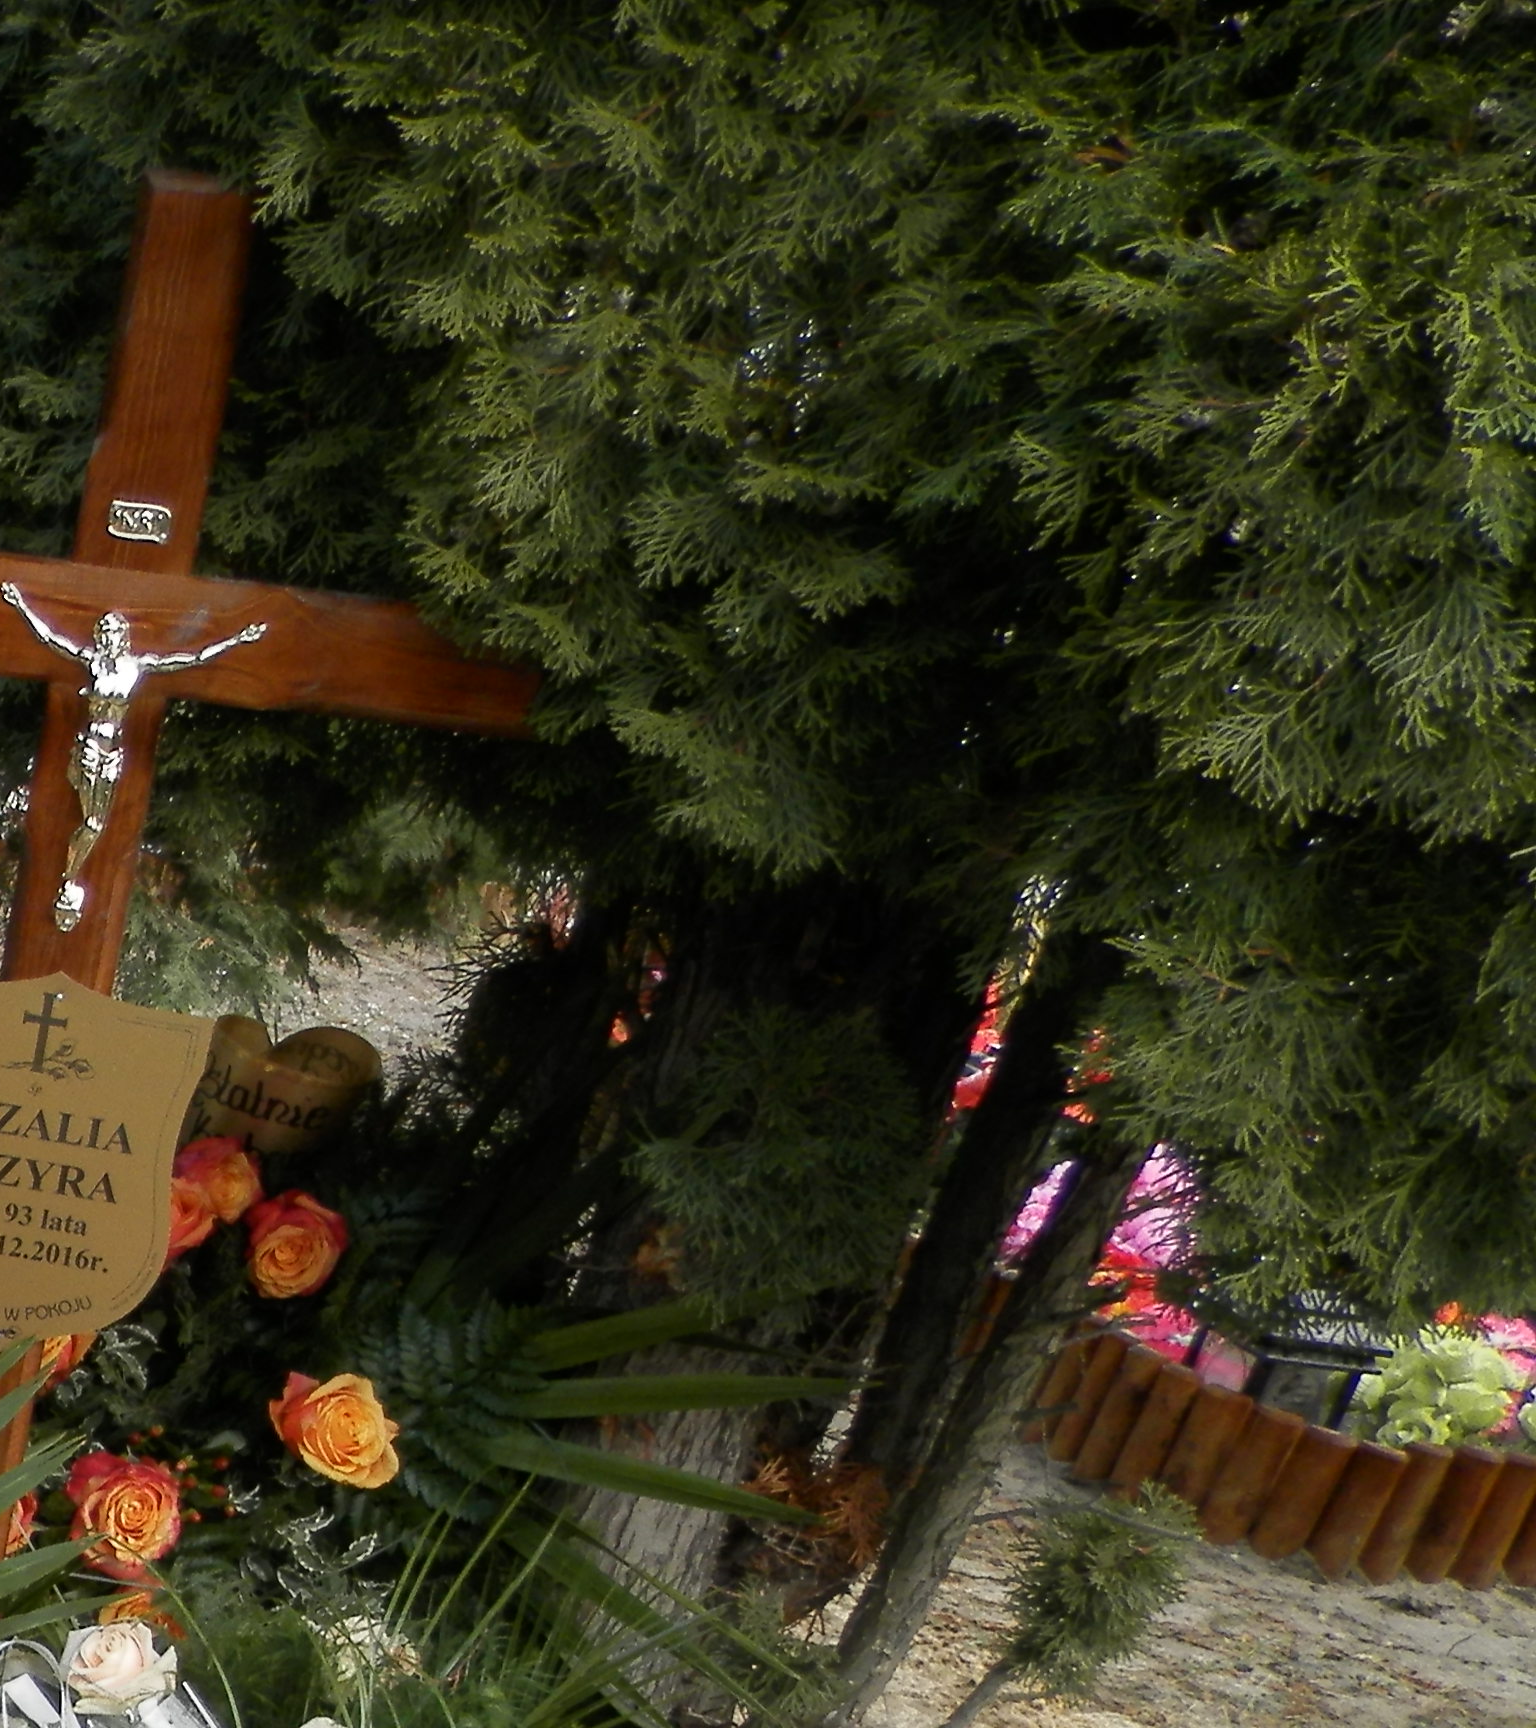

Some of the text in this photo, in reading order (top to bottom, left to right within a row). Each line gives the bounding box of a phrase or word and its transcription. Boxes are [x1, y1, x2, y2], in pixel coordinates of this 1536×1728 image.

[4, 1202, 33, 1227] 93
[40, 1208, 88, 1237] lata
[4, 1306, 20, 1322] W
[24, 1295, 93, 1321] POKOJU
